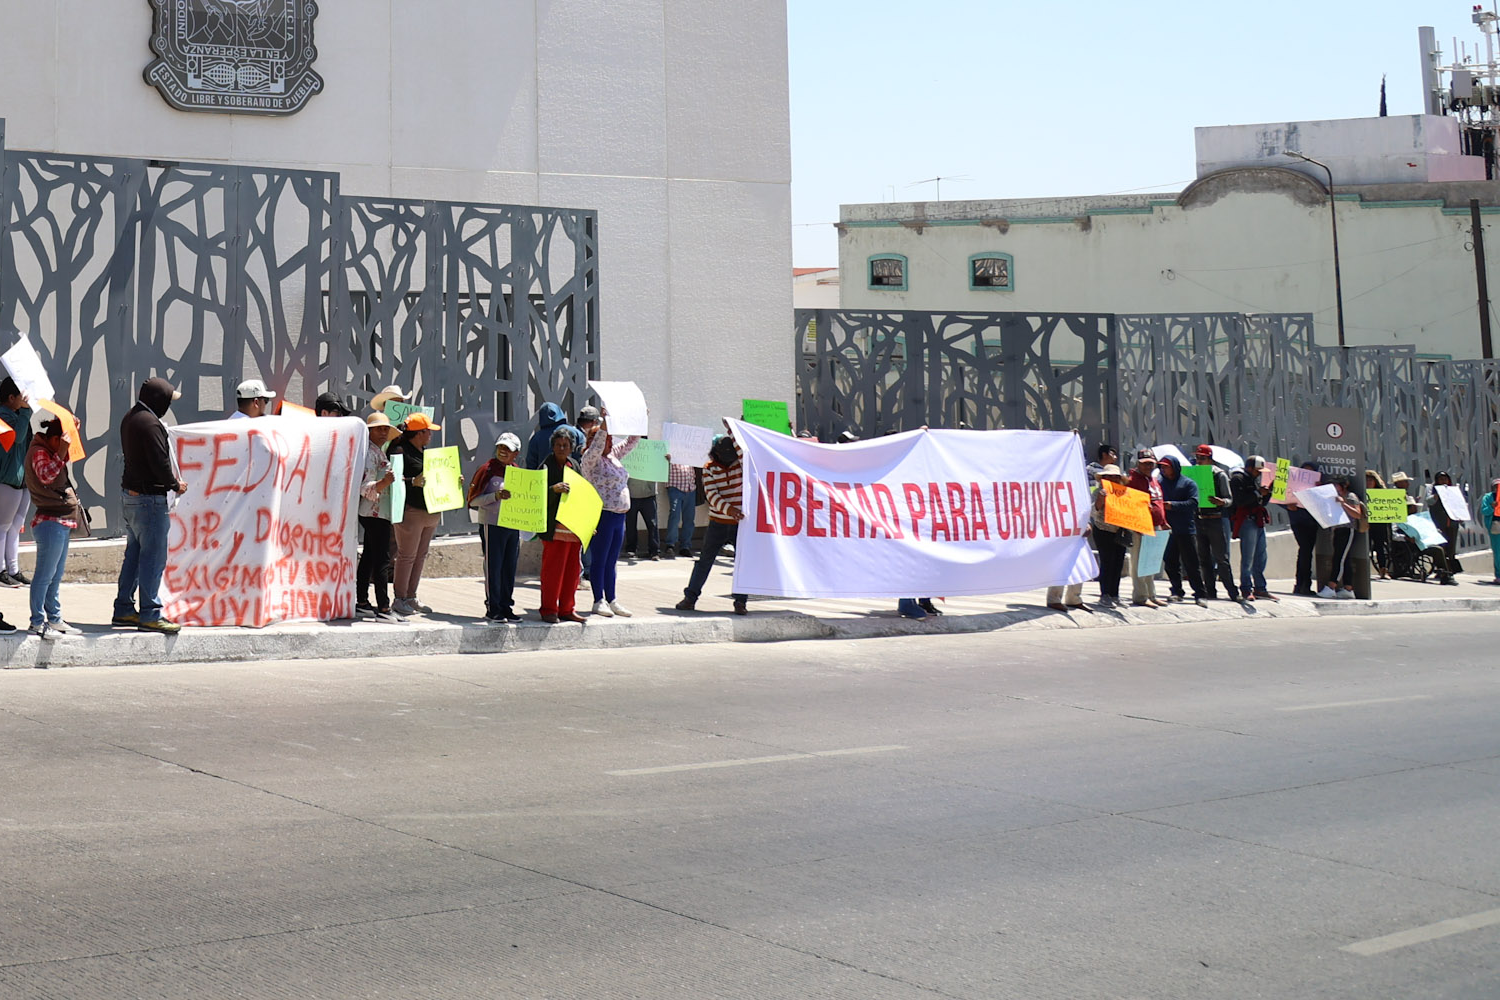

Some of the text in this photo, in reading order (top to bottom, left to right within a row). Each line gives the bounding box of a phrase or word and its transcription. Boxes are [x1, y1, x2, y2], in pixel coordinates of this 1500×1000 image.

[182, 44, 289, 60] Y EN LA ESPERANZA
[158, 68, 314, 108] ESTADO LIBRE Y SOBERANO DE PUEBLA
[1315, 443, 1356, 453] CUIDADO
[1316, 456, 1356, 466] ACCESO DE
[1317, 465, 1357, 476] AUTOS
[513, 490, 541, 503] ontigo
[756, 471, 905, 540] LIBERTAD
[902, 482, 990, 542] PARA
[992, 481, 1081, 540] URUVIEL
